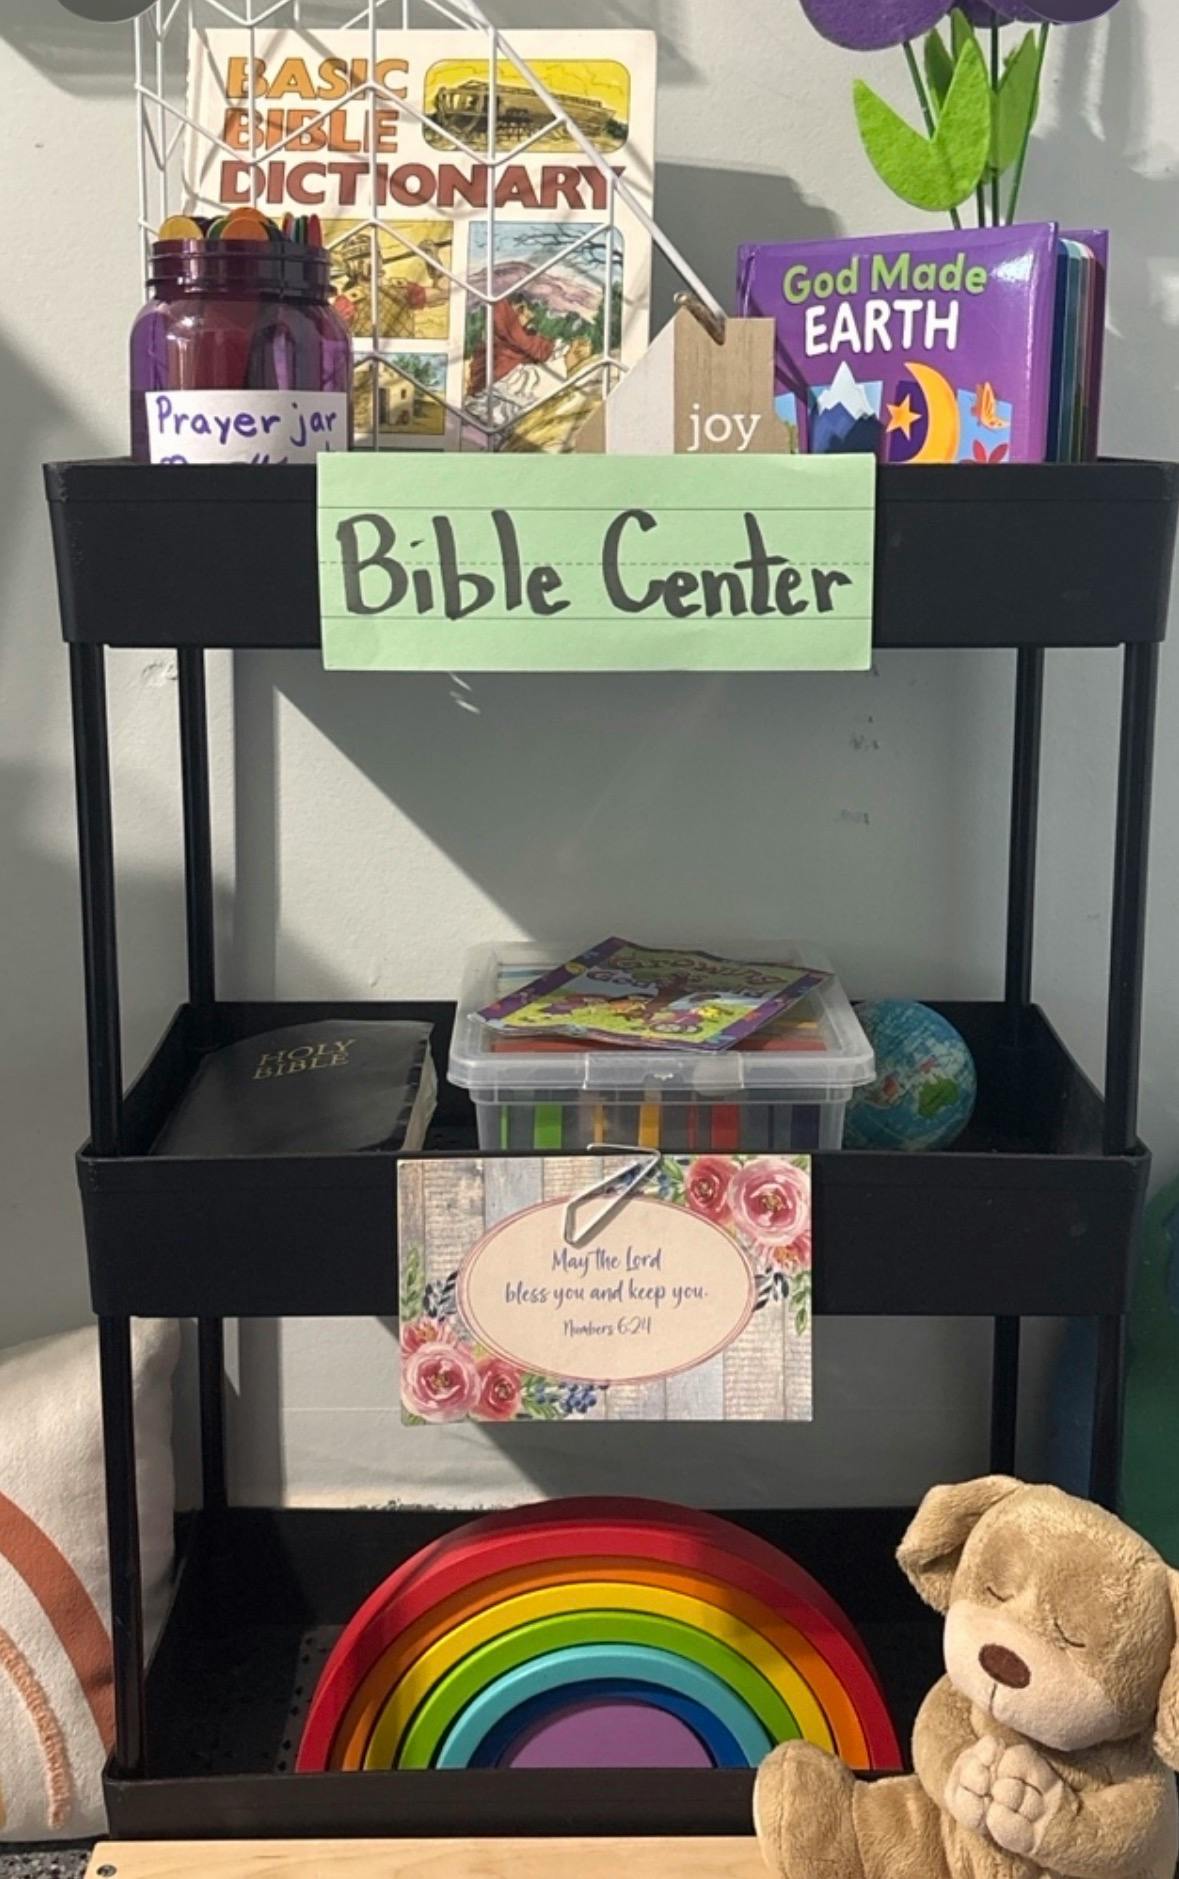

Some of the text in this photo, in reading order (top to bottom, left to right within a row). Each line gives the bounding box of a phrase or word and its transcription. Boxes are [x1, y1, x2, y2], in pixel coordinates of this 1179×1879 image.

[224, 56, 409, 101] BASIC
[221, 107, 399, 153] BIBLE
[218, 160, 626, 211] DICTIONARY
[782, 251, 988, 305] God Made
[805, 298, 959, 357] EARTH
[155, 395, 337, 447] Prayer jar
[686, 402, 762, 452] joy
[336, 508, 853, 621] Bible Center
[252, 1053, 350, 1080] BIBLE
[258, 1039, 357, 1066] HOLY
[551, 1246, 662, 1278] May the Lord
[505, 1278, 709, 1310] bless you and keep you.
[563, 1316, 652, 1337] Numbers 6:24
